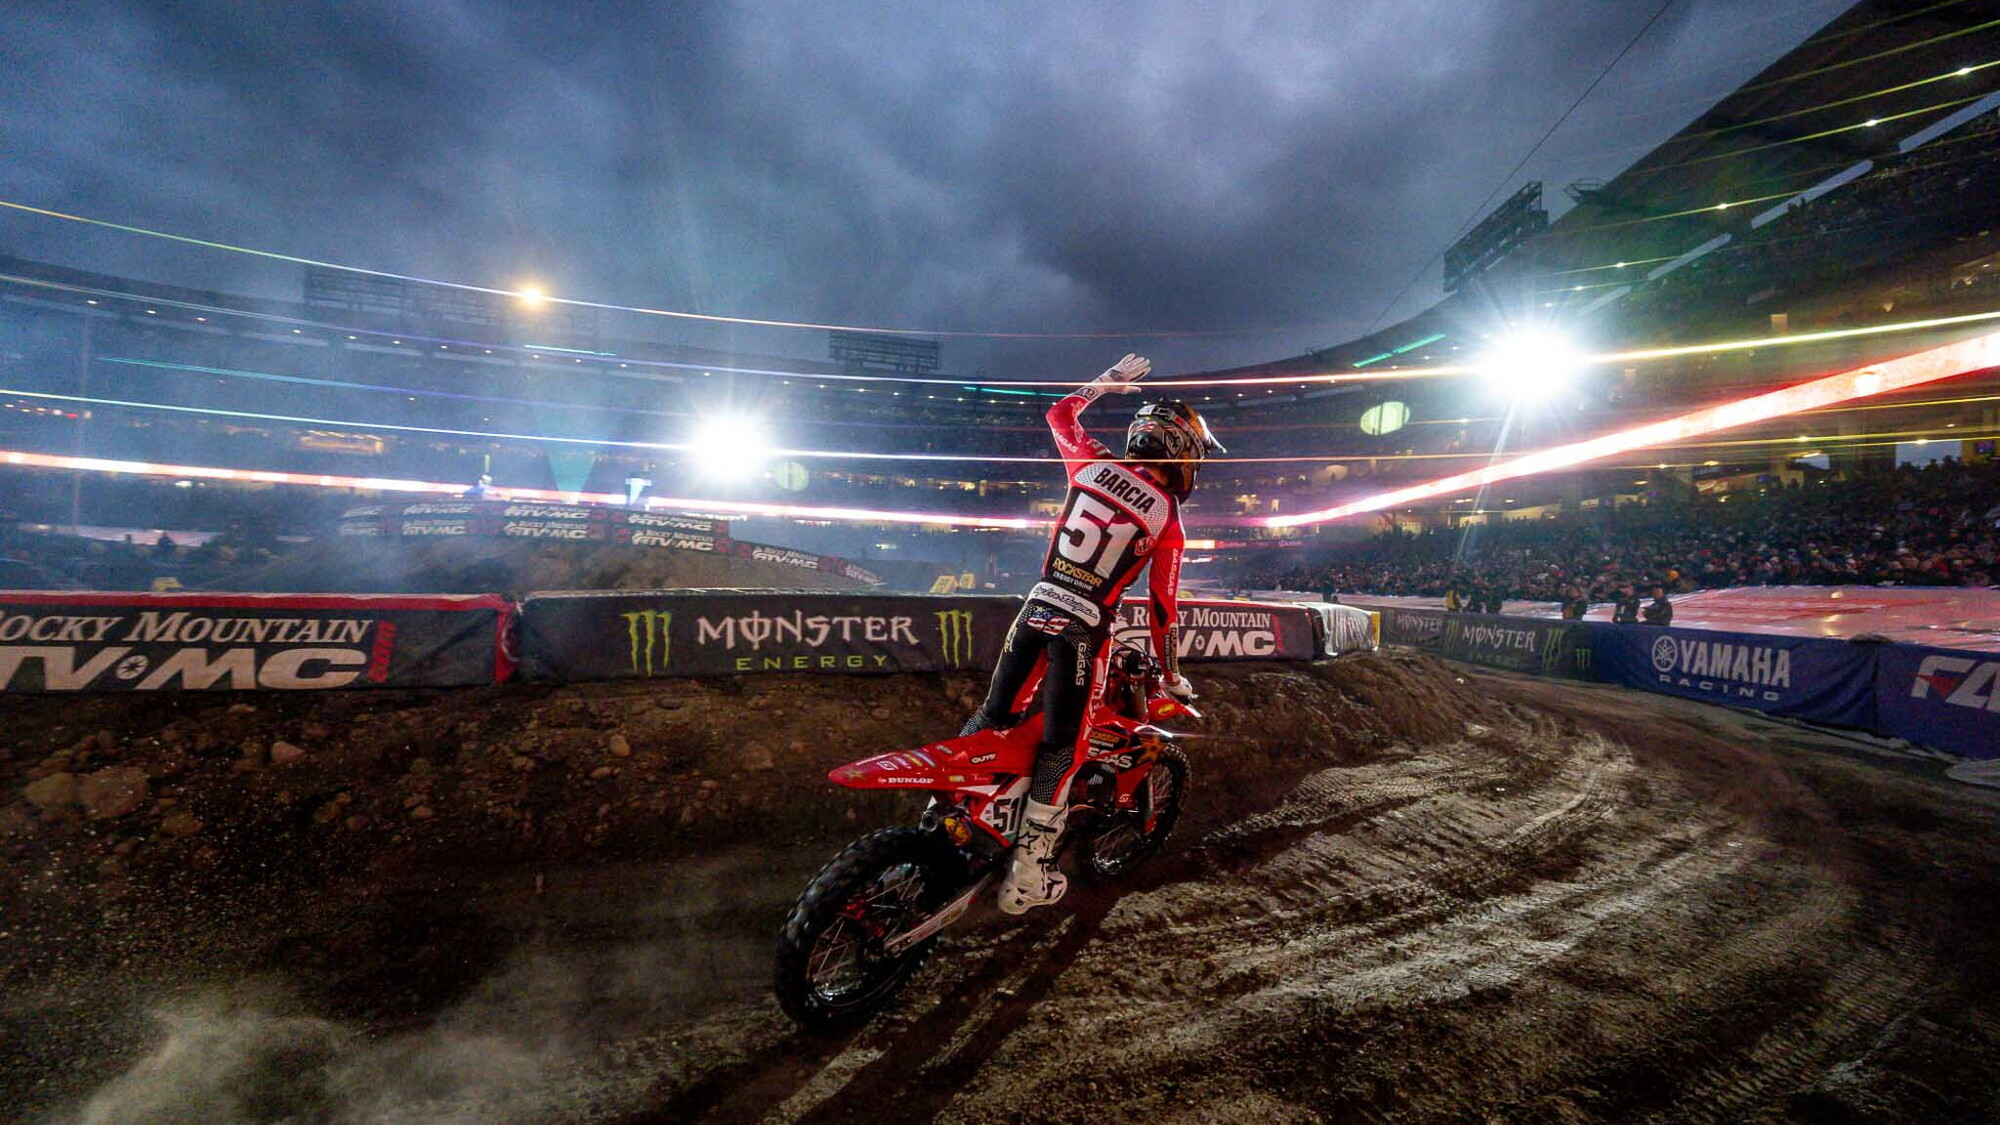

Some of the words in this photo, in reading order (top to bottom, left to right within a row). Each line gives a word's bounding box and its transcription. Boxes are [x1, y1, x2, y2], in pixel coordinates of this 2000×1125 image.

[1093, 468, 1156, 513] BARCIA
[1058, 491, 1139, 580] 51
[1052, 557, 1103, 588] ROCKSTAR
[1073, 579, 1093, 591] DRINK
[0, 608, 124, 642] OCKY
[122, 611, 373, 643] MOUNTAIN
[697, 610, 920, 651] MONSTER
[1192, 607, 1270, 629] MOUNTAIN
[1462, 623, 1536, 652] MONSTER
[735, 655, 888, 671] ENERGY
[1680, 639, 1790, 688] YAMAHA
[1659, 675, 1780, 702] RACING
[993, 797, 1020, 833] 51
